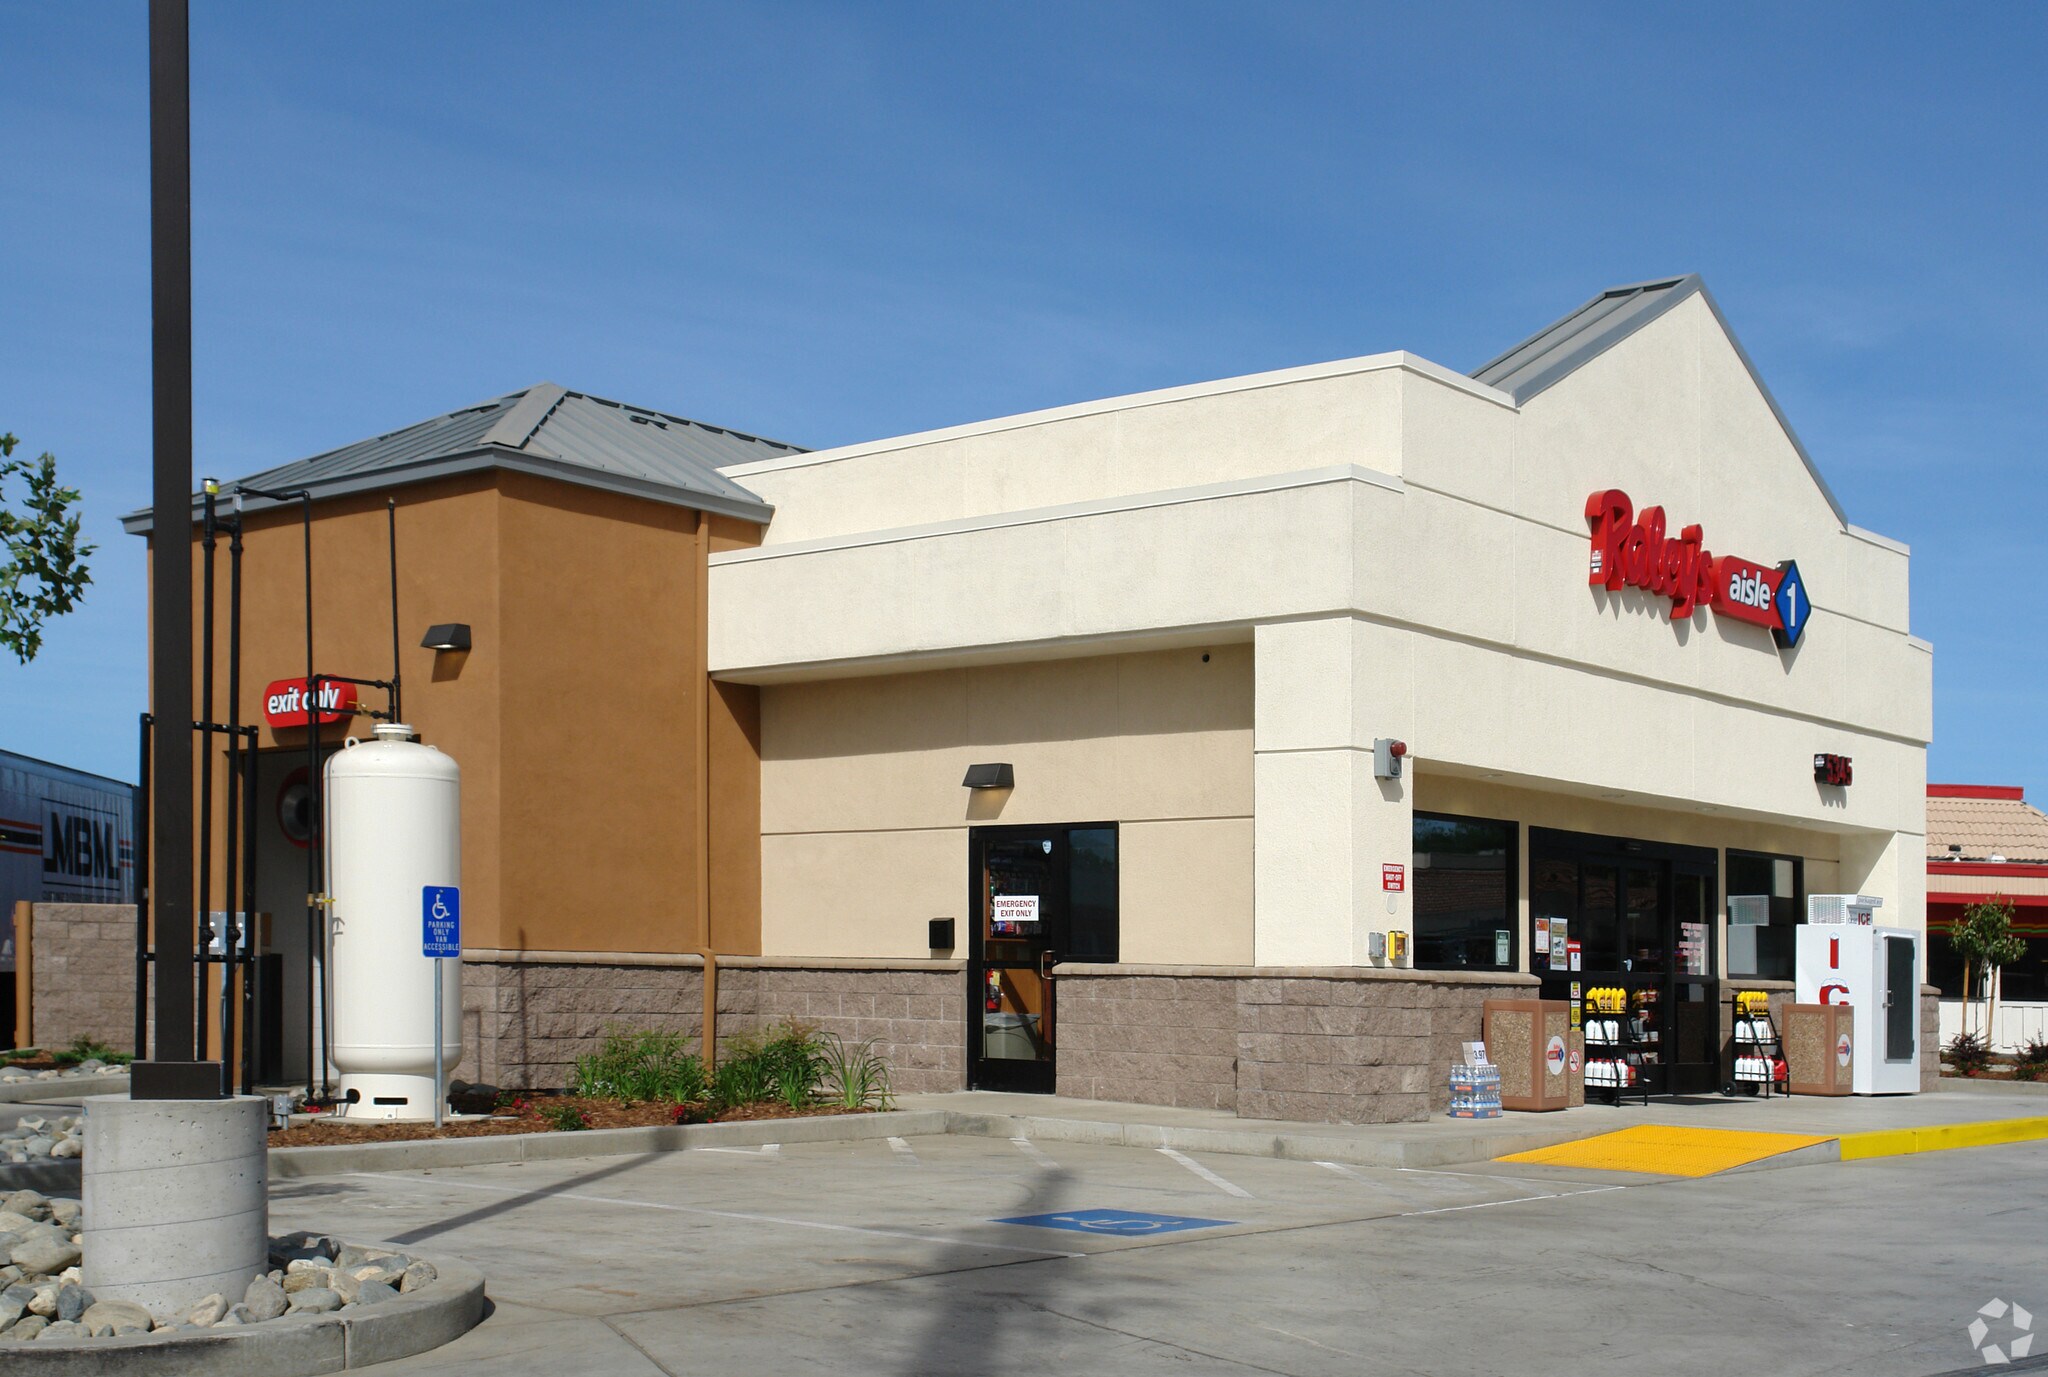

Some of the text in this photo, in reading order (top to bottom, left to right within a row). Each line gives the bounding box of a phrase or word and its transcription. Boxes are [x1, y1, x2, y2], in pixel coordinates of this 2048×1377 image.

[1729, 569, 1771, 611] aisle
[1786, 582, 1797, 628] 1
[267, 686, 300, 715] exit
[1826, 753, 1852, 785] 5345
[996, 900, 1036, 908] EMERGENCY
[1000, 909, 1032, 917] EXIT ONLY
[1858, 912, 1871, 926] ICE
[427, 921, 455, 929] PARKING
[433, 928, 449, 936] ONLY
[1473, 1050, 1485, 1060] 3.97
